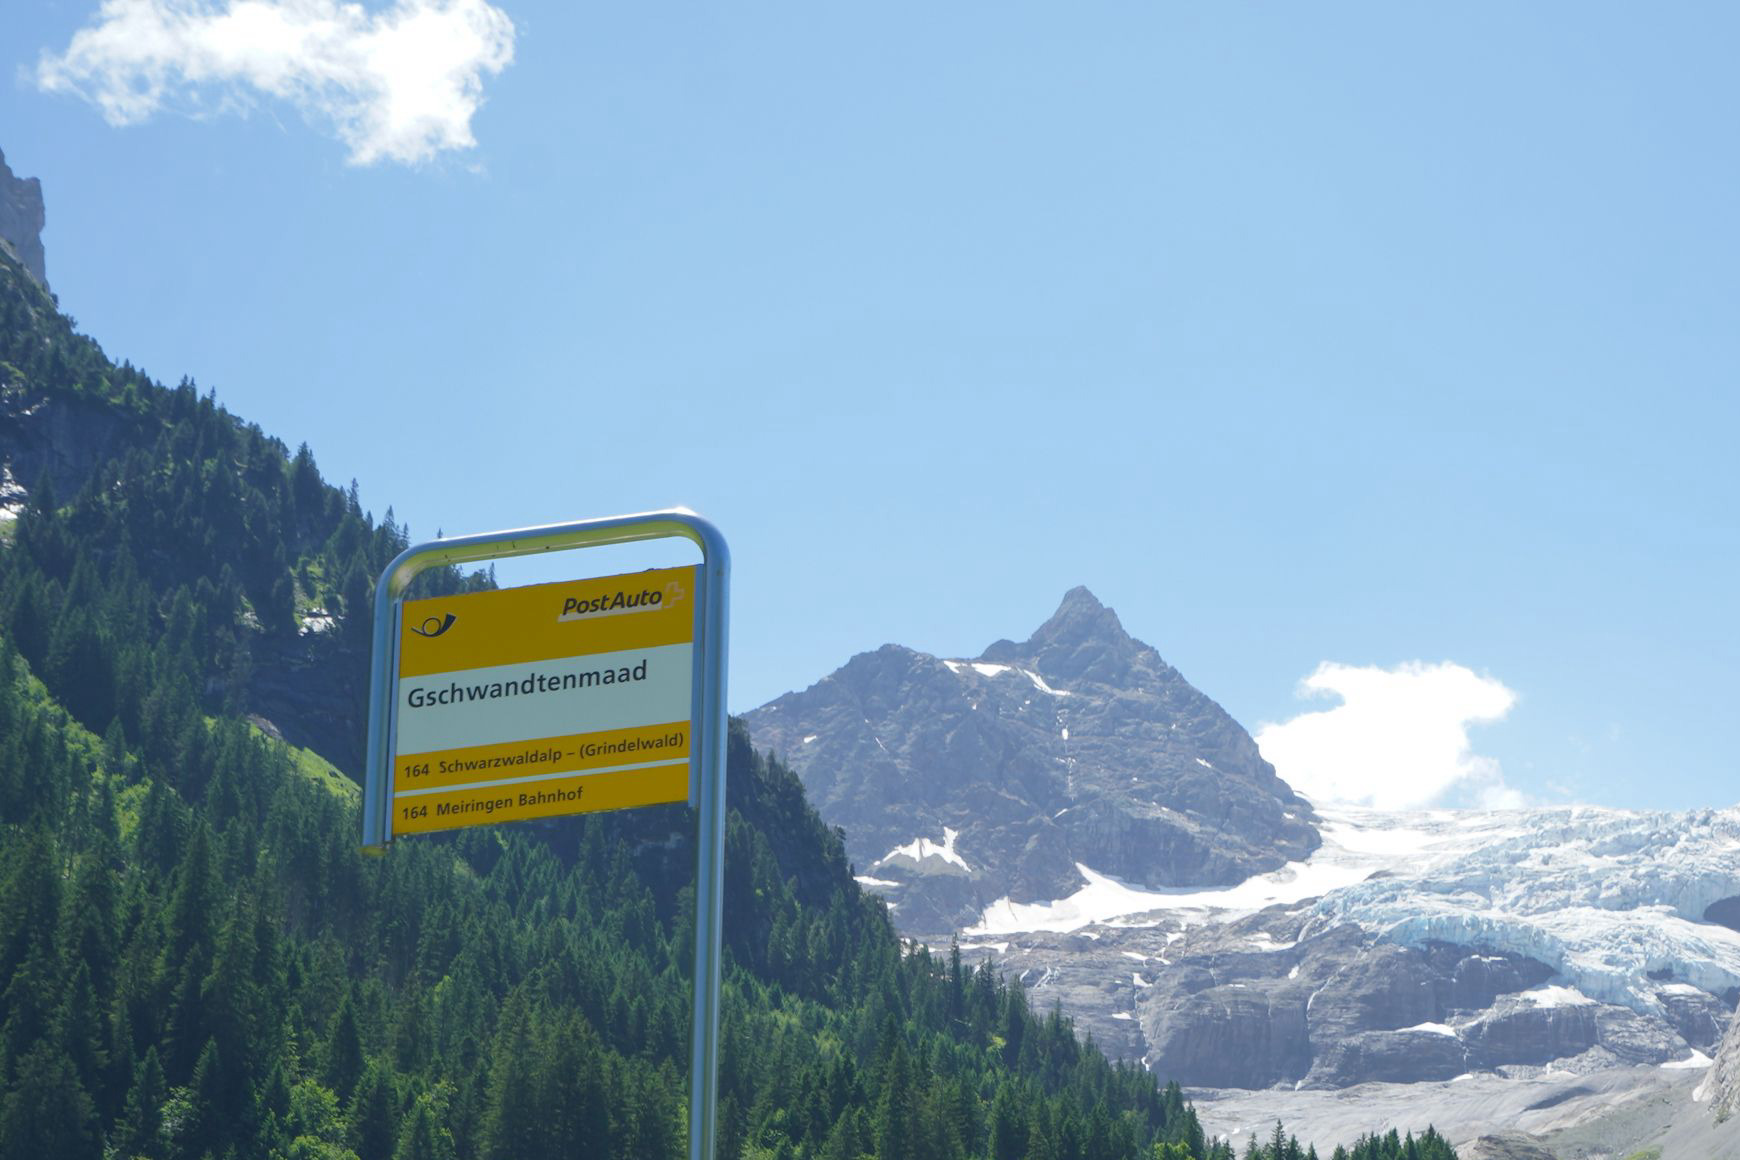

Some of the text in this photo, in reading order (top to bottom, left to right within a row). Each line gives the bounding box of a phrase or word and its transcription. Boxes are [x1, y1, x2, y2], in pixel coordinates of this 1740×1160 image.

[562, 589, 662, 615] PostAuto
[407, 659, 648, 708] Gschwandtenmaad
[404, 763, 430, 778] 164
[439, 747, 562, 774] Schwarzwaldalp
[579, 732, 684, 760] (Grindelwald)
[402, 786, 584, 820] 164 Meiringen Bahnhof
